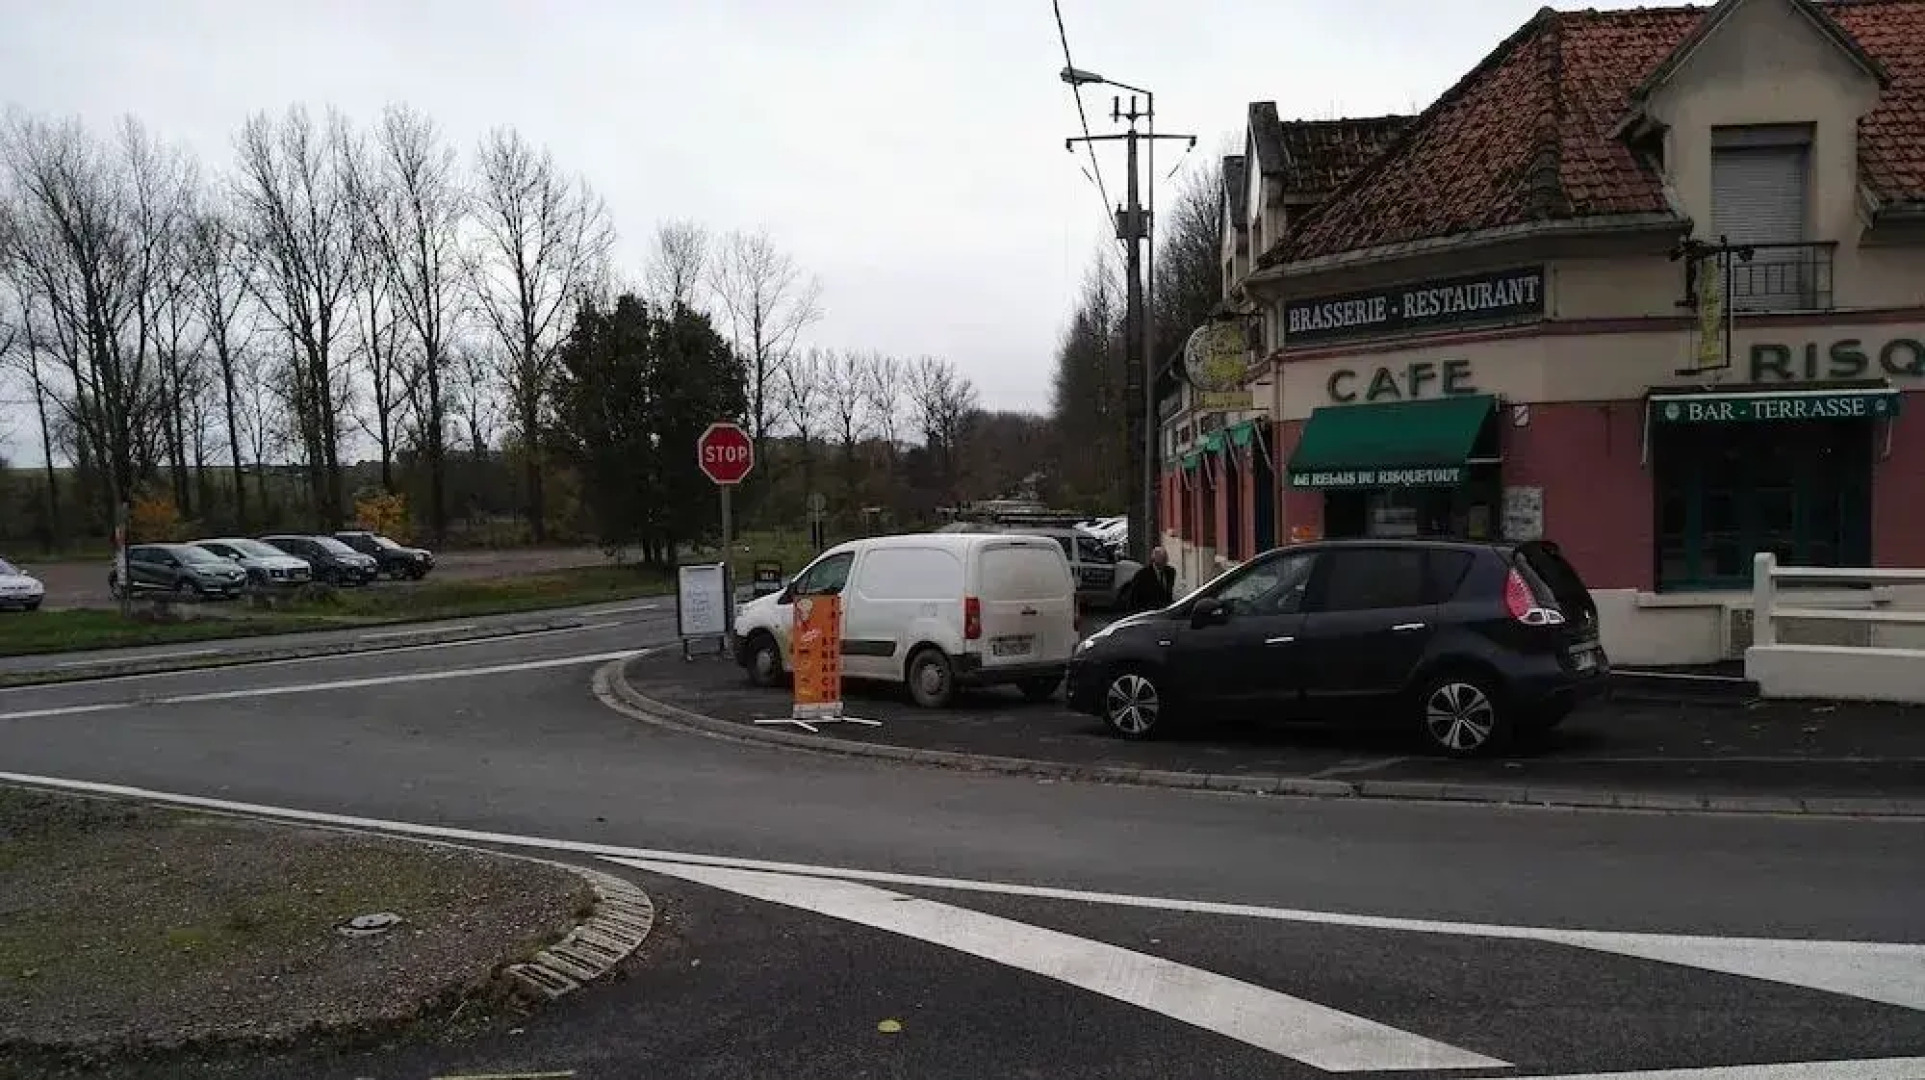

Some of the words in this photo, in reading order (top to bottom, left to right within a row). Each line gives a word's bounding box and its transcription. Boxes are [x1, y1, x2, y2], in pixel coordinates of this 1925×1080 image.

[1289, 296, 1386, 332] BRASSERIE
[1403, 275, 1538, 318] RESTAURANT
[1327, 360, 1477, 402] CAFE
[1688, 402, 1734, 420] BAR
[1752, 399, 1865, 419] TERRASSE
[705, 445, 748, 463] STOP
[1312, 471, 1355, 486] RELAIS
[1358, 471, 1375, 484] DU
[1378, 469, 1460, 486] RISQUETOUT
